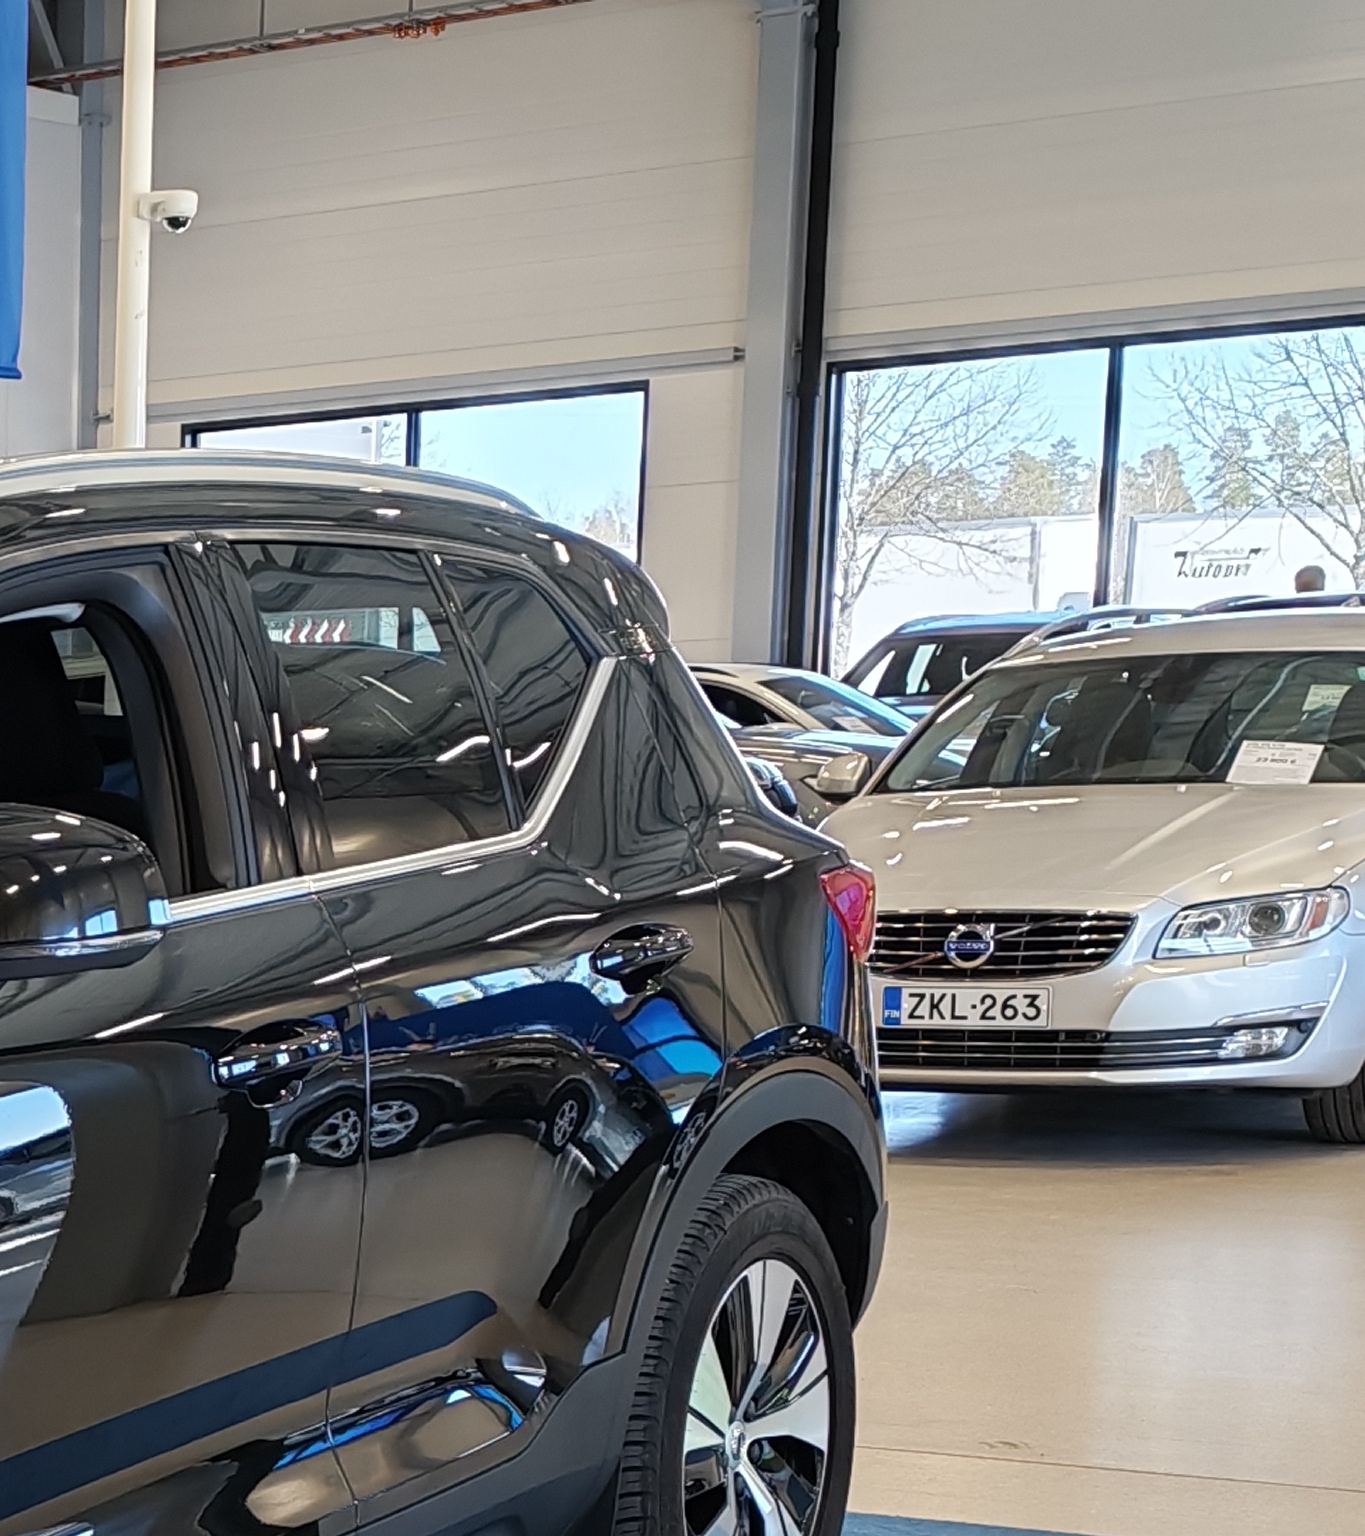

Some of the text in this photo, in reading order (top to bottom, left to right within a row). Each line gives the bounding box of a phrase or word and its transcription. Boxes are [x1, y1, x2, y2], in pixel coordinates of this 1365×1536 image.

[948, 942, 989, 950] VOLVO
[907, 993, 1042, 1021] ZKL-263
[884, 1009, 900, 1019] FIN
